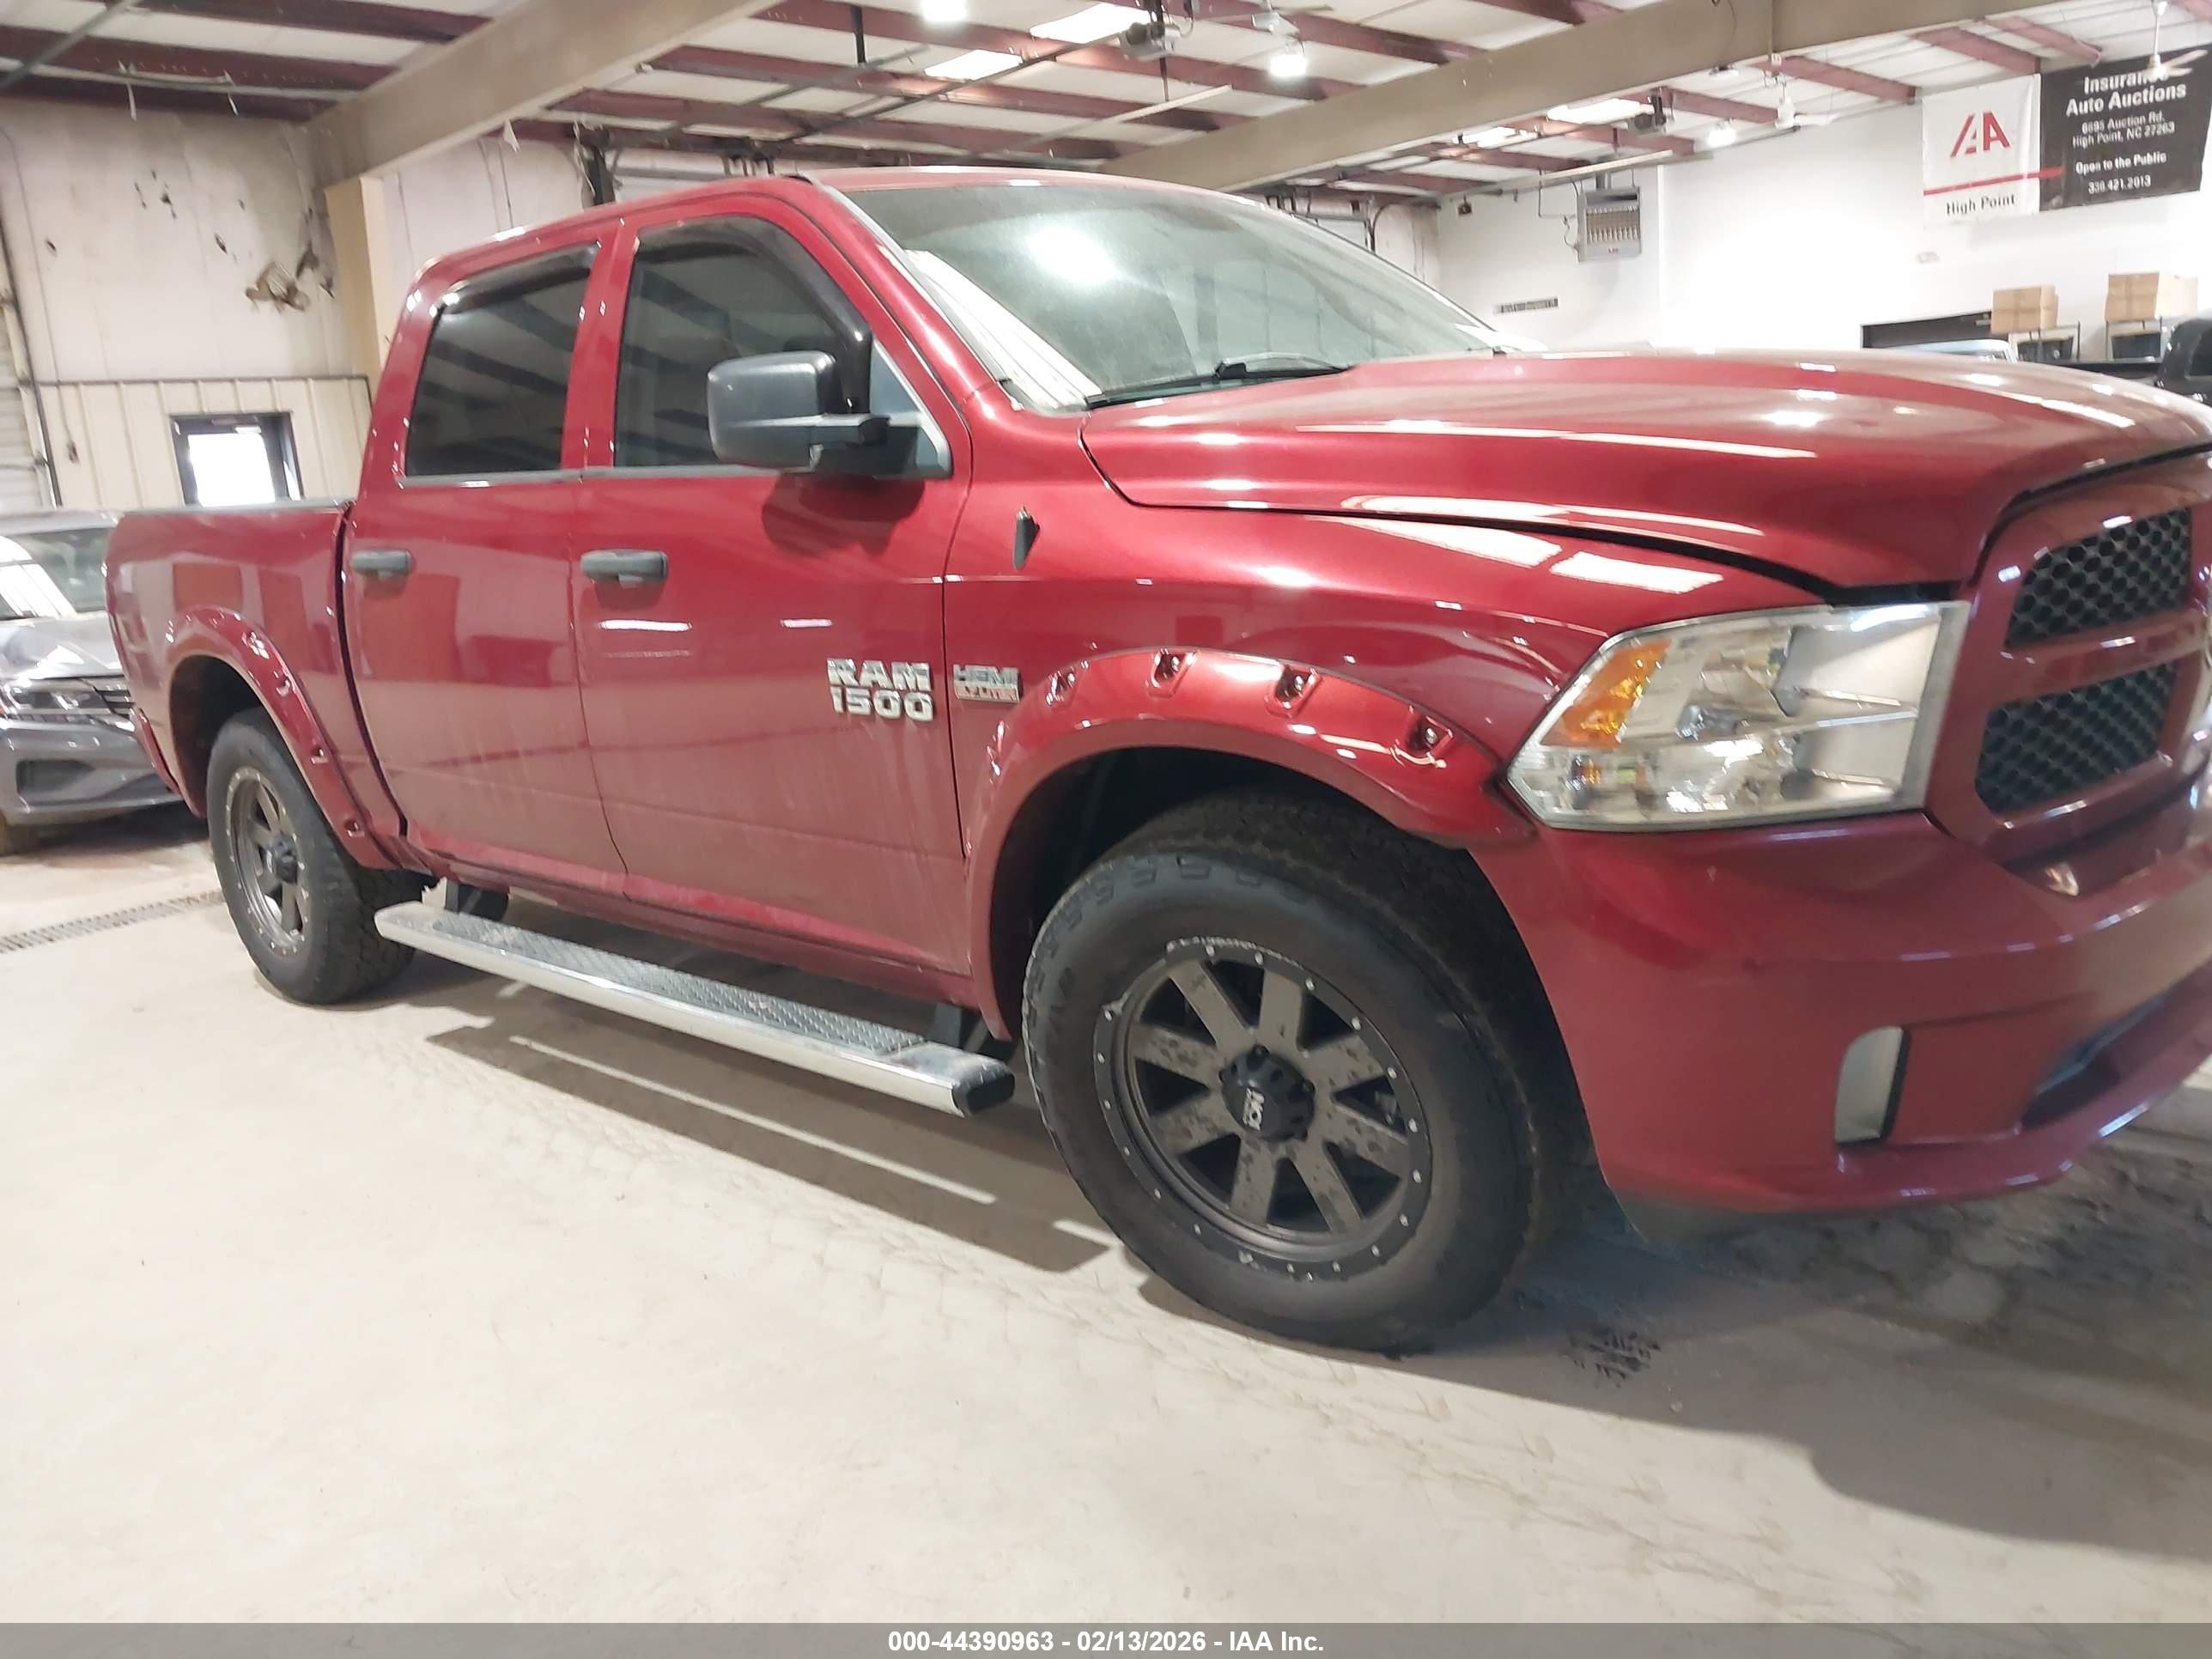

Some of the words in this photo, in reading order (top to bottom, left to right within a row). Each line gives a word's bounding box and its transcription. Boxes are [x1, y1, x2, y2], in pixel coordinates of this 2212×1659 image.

[2066, 97, 2104, 117] Auto
[2108, 84, 2186, 110] Auctions
[2107, 115, 2146, 130] Auction
[2148, 110, 2166, 123] Rd.
[2072, 135, 2094, 149] High
[2097, 130, 2124, 144] Point,
[2126, 126, 2142, 140] NC
[2075, 161, 2101, 176] Open
[2103, 160, 2112, 170] to
[2114, 156, 2131, 169] the
[2133, 151, 2167, 167] Public
[1947, 198, 1977, 215] High
[1980, 193, 2015, 210] Point
[826, 658, 932, 692] RAM
[953, 664, 1019, 687] HEMI
[830, 686, 934, 722] 1500
